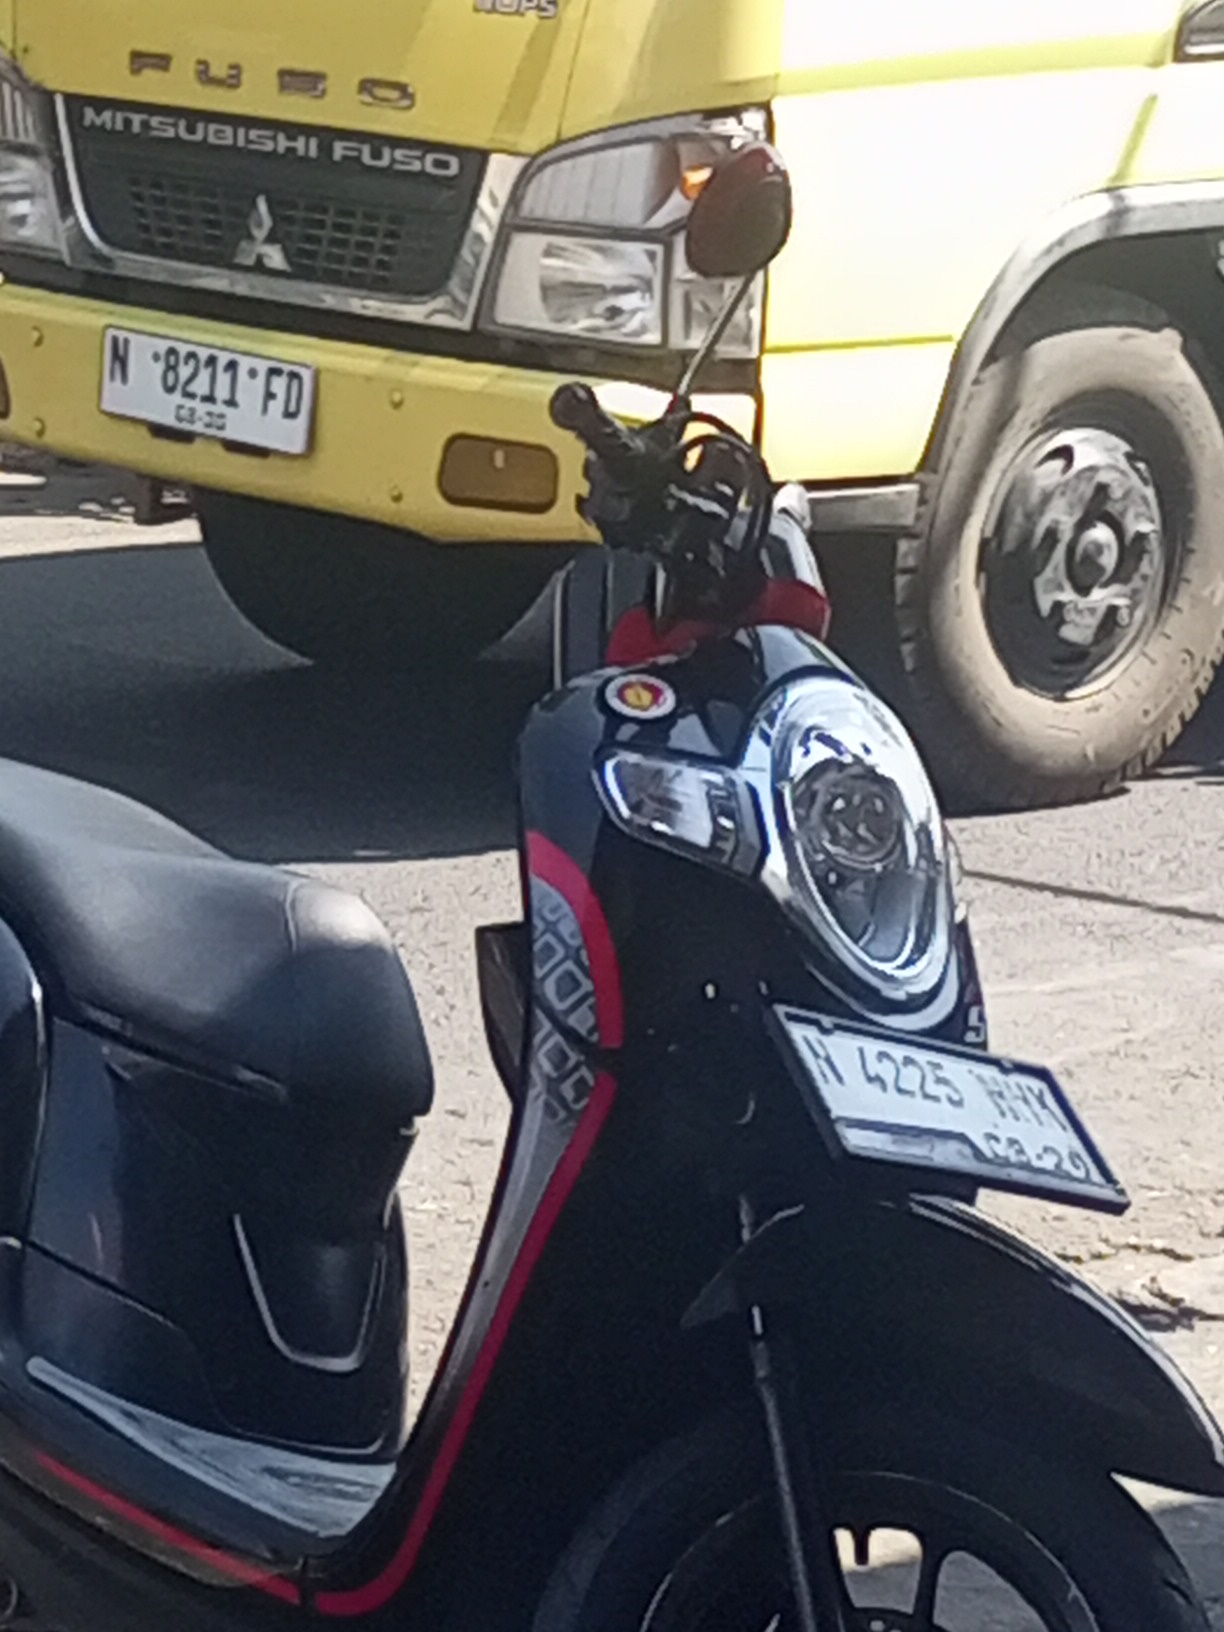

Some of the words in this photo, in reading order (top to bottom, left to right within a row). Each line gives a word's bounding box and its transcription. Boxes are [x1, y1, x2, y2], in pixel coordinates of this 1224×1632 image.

[129, 50, 416, 108] FUSO
[82, 105, 319, 160] MITSUBISHI
[332, 140, 460, 178] FUSO
[109, 334, 130, 386] N
[161, 346, 241, 409] 8211
[261, 366, 304, 421] FD
[857, 1045, 965, 1109] 4225
